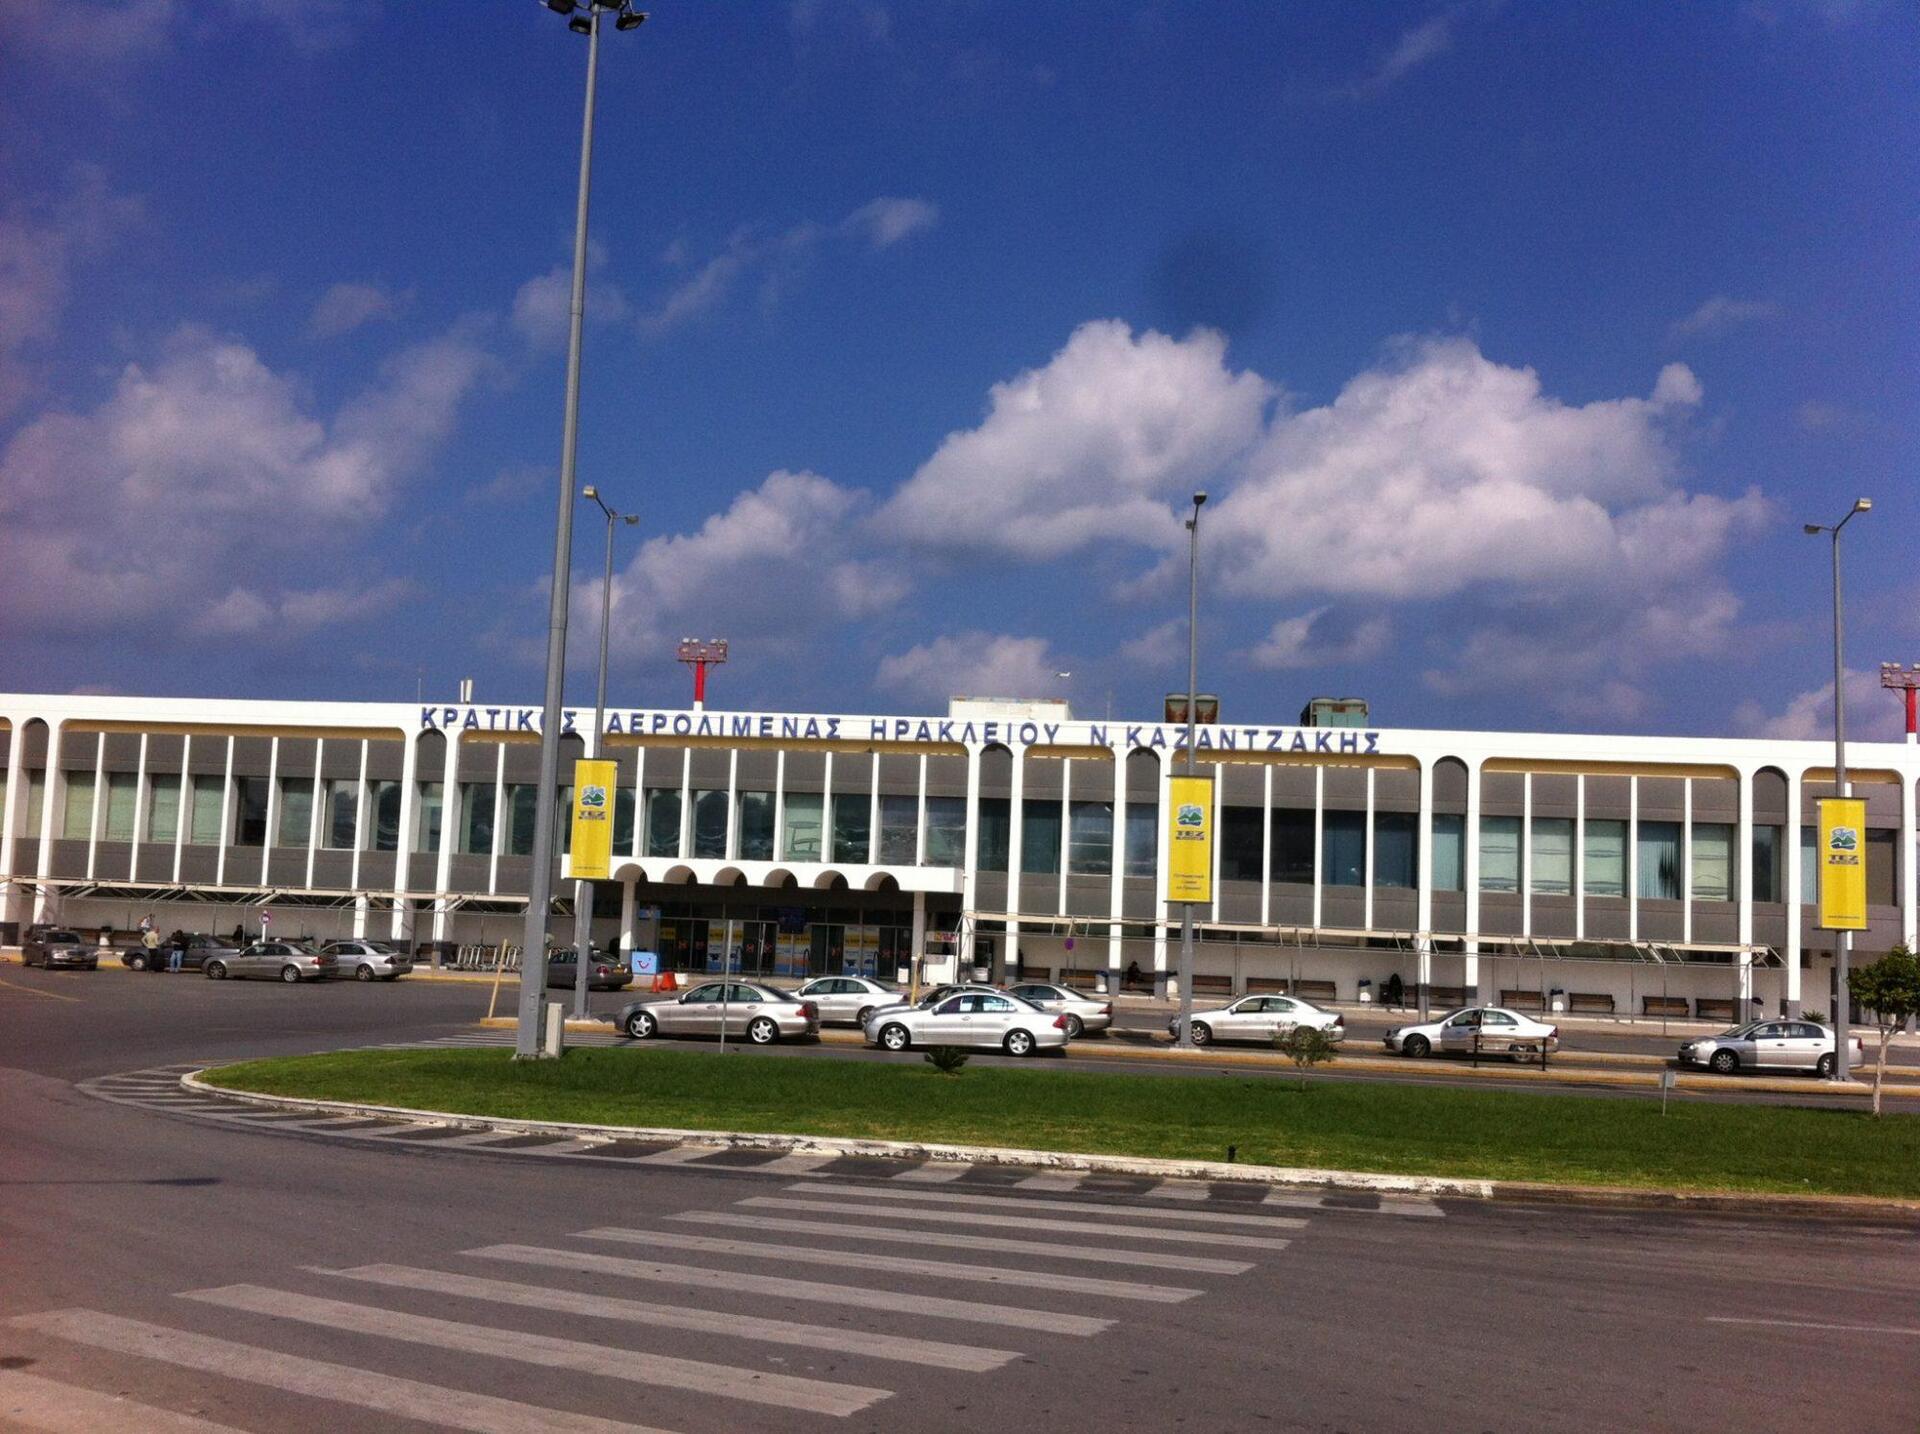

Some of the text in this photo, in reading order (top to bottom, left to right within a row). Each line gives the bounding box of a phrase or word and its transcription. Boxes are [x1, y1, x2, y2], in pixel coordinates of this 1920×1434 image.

[421, 706, 578, 733] ΚΡΑΤΙΚΣ
[606, 711, 842, 740] ΑΕΡΟΛΙΜΕΝΑΣ
[870, 718, 1061, 746] ΗΡΑΚΛΕΙΟΥ
